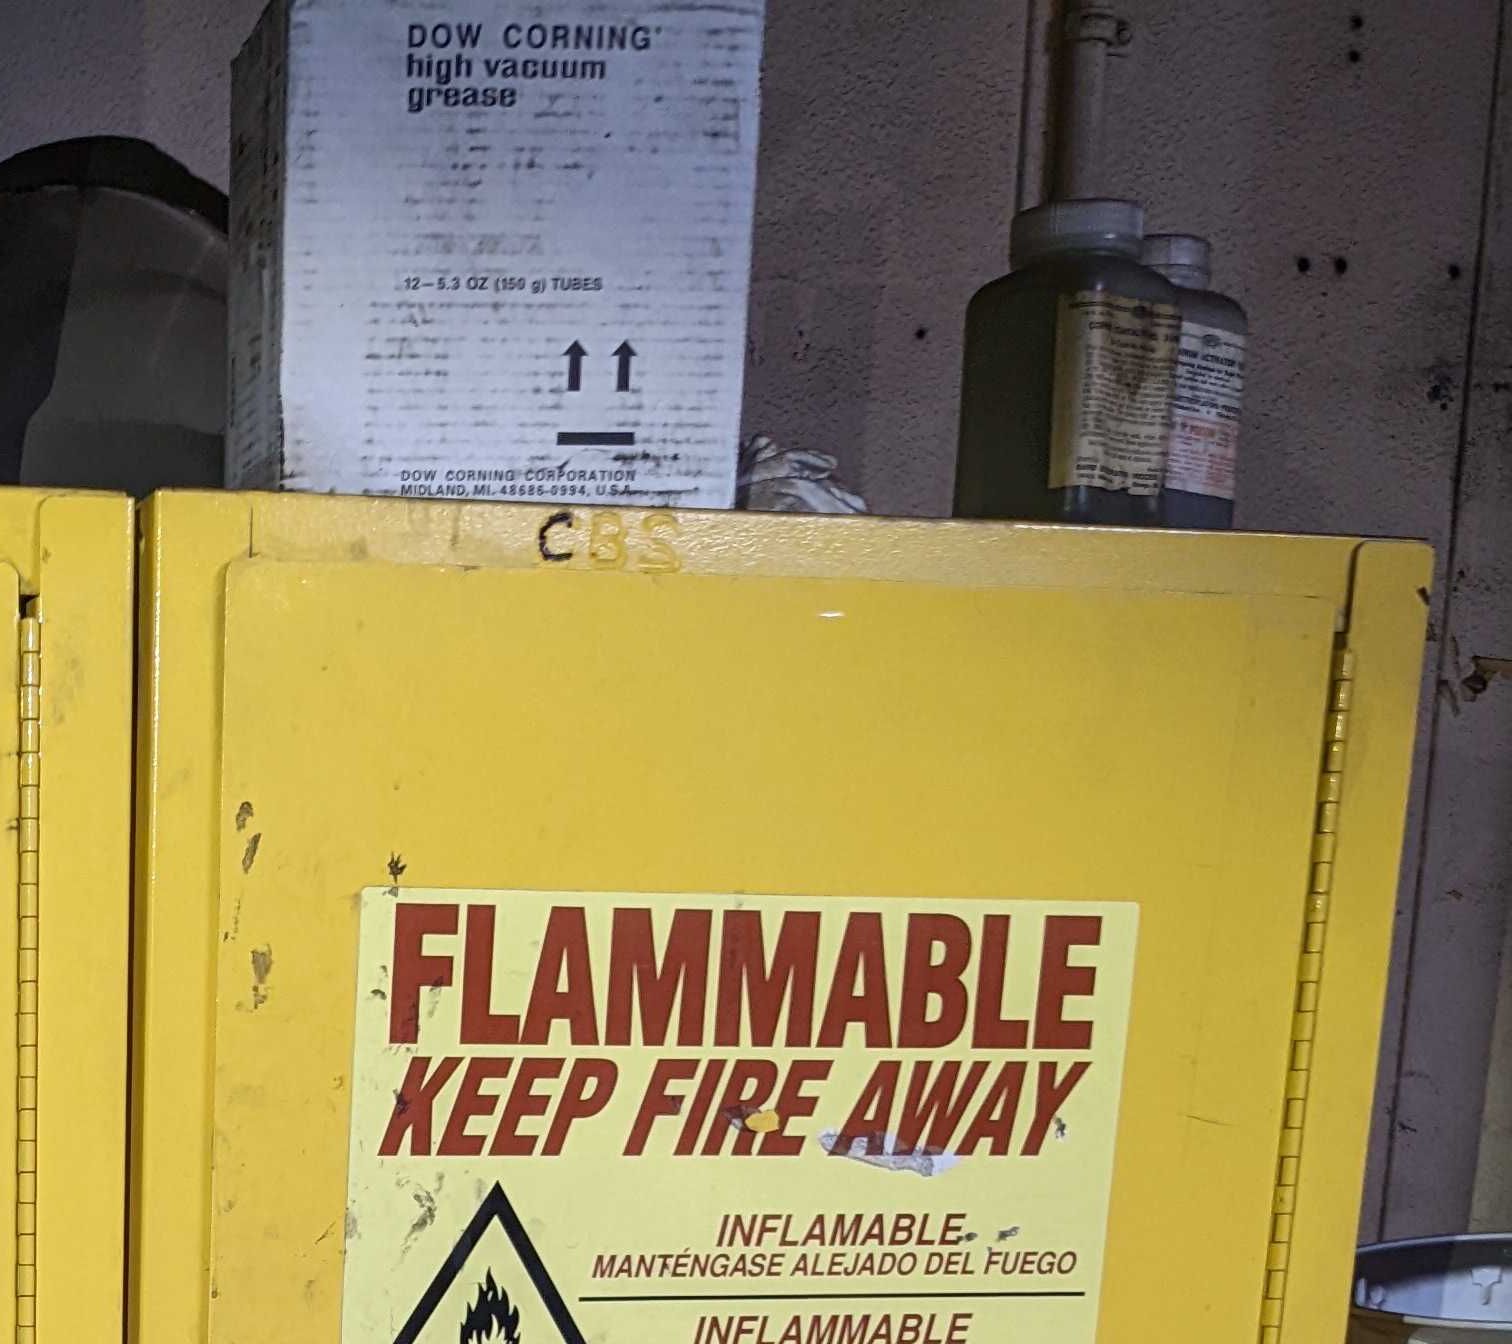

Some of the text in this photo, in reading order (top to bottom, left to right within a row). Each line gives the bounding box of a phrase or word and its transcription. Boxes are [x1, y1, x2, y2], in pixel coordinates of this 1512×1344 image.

[408, 23, 482, 49] DOW
[407, 53, 606, 85] high vacuum
[408, 86, 517, 113] grease
[466, 277, 489, 290] OZ
[551, 277, 603, 291] TUBES
[400, 469, 636, 482] DOW CORNING CORPORATION
[389, 902, 1104, 1051] FLAMMABLE
[378, 1056, 1093, 1158] KEEP FIRE AWAY
[716, 1213, 967, 1248] INFLAMABLE
[592, 1248, 1077, 1279] MANTÉNGASE ALEJADO DEL FUEGO
